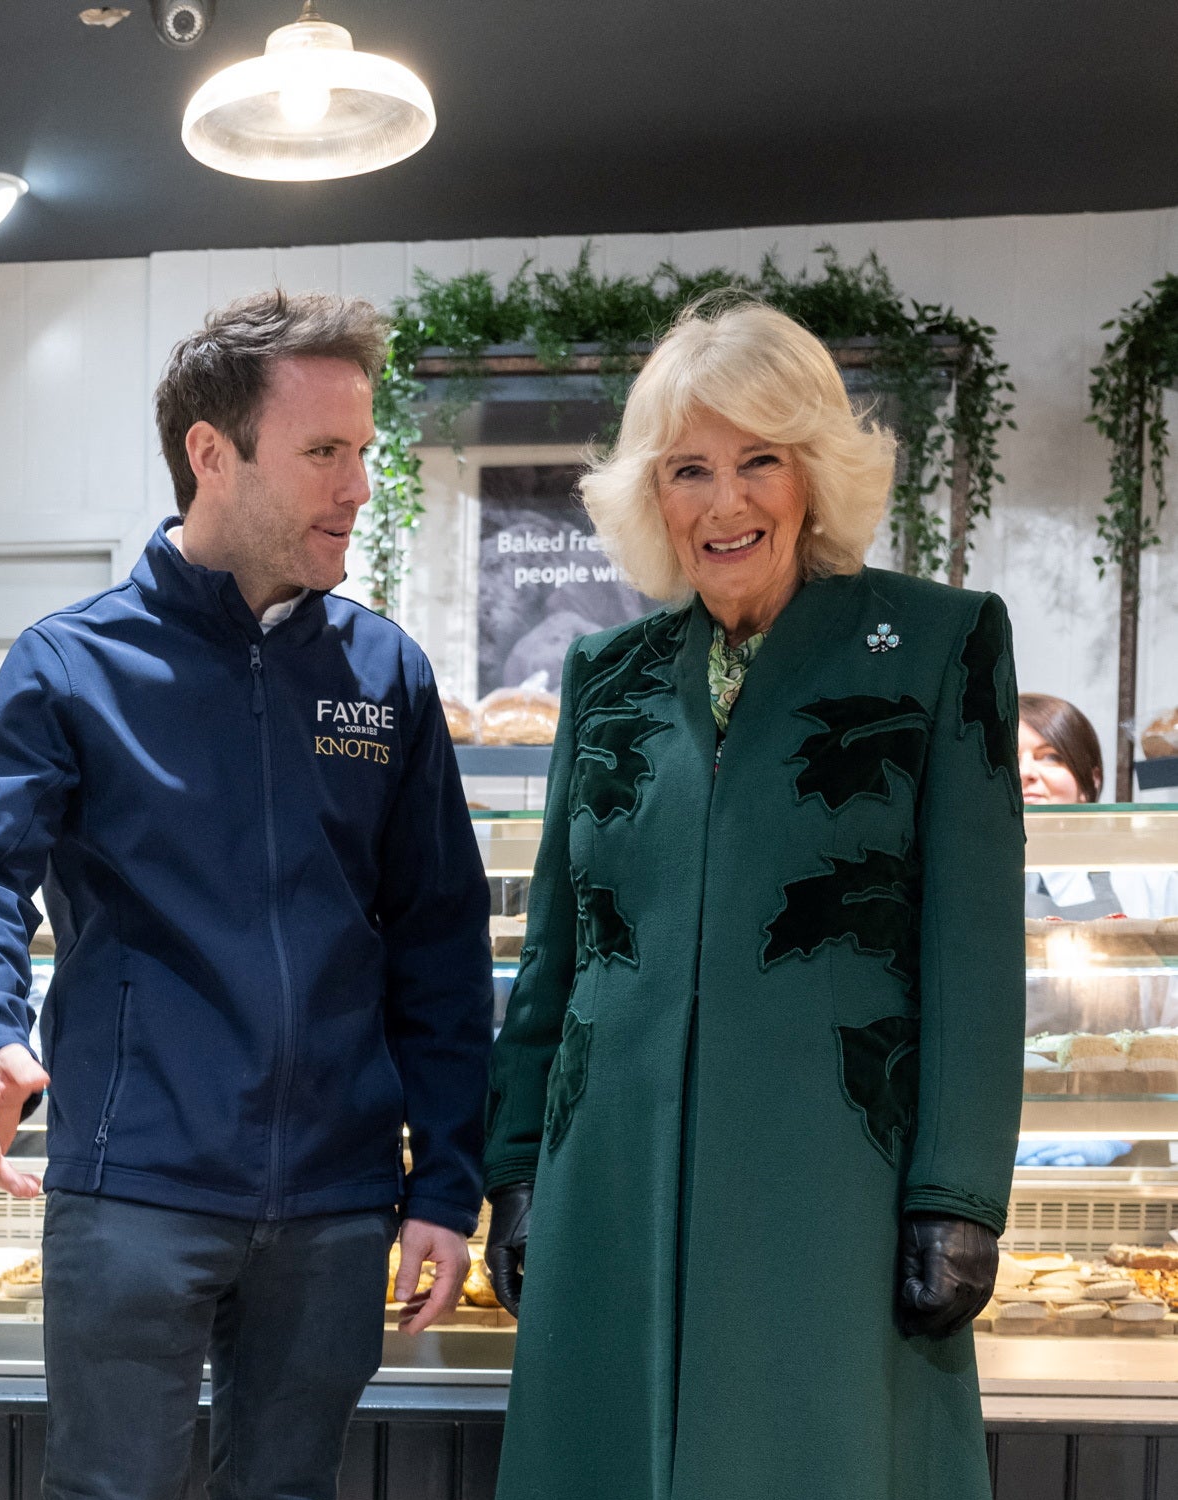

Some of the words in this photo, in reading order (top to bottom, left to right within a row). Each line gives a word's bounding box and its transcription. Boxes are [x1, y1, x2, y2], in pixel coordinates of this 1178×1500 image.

[498, 530, 565, 553] Baked
[514, 562, 590, 588] people
[317, 700, 394, 729] FAYRE
[345, 725, 378, 736] CORRIES
[315, 736, 390, 764] KNOTTS
